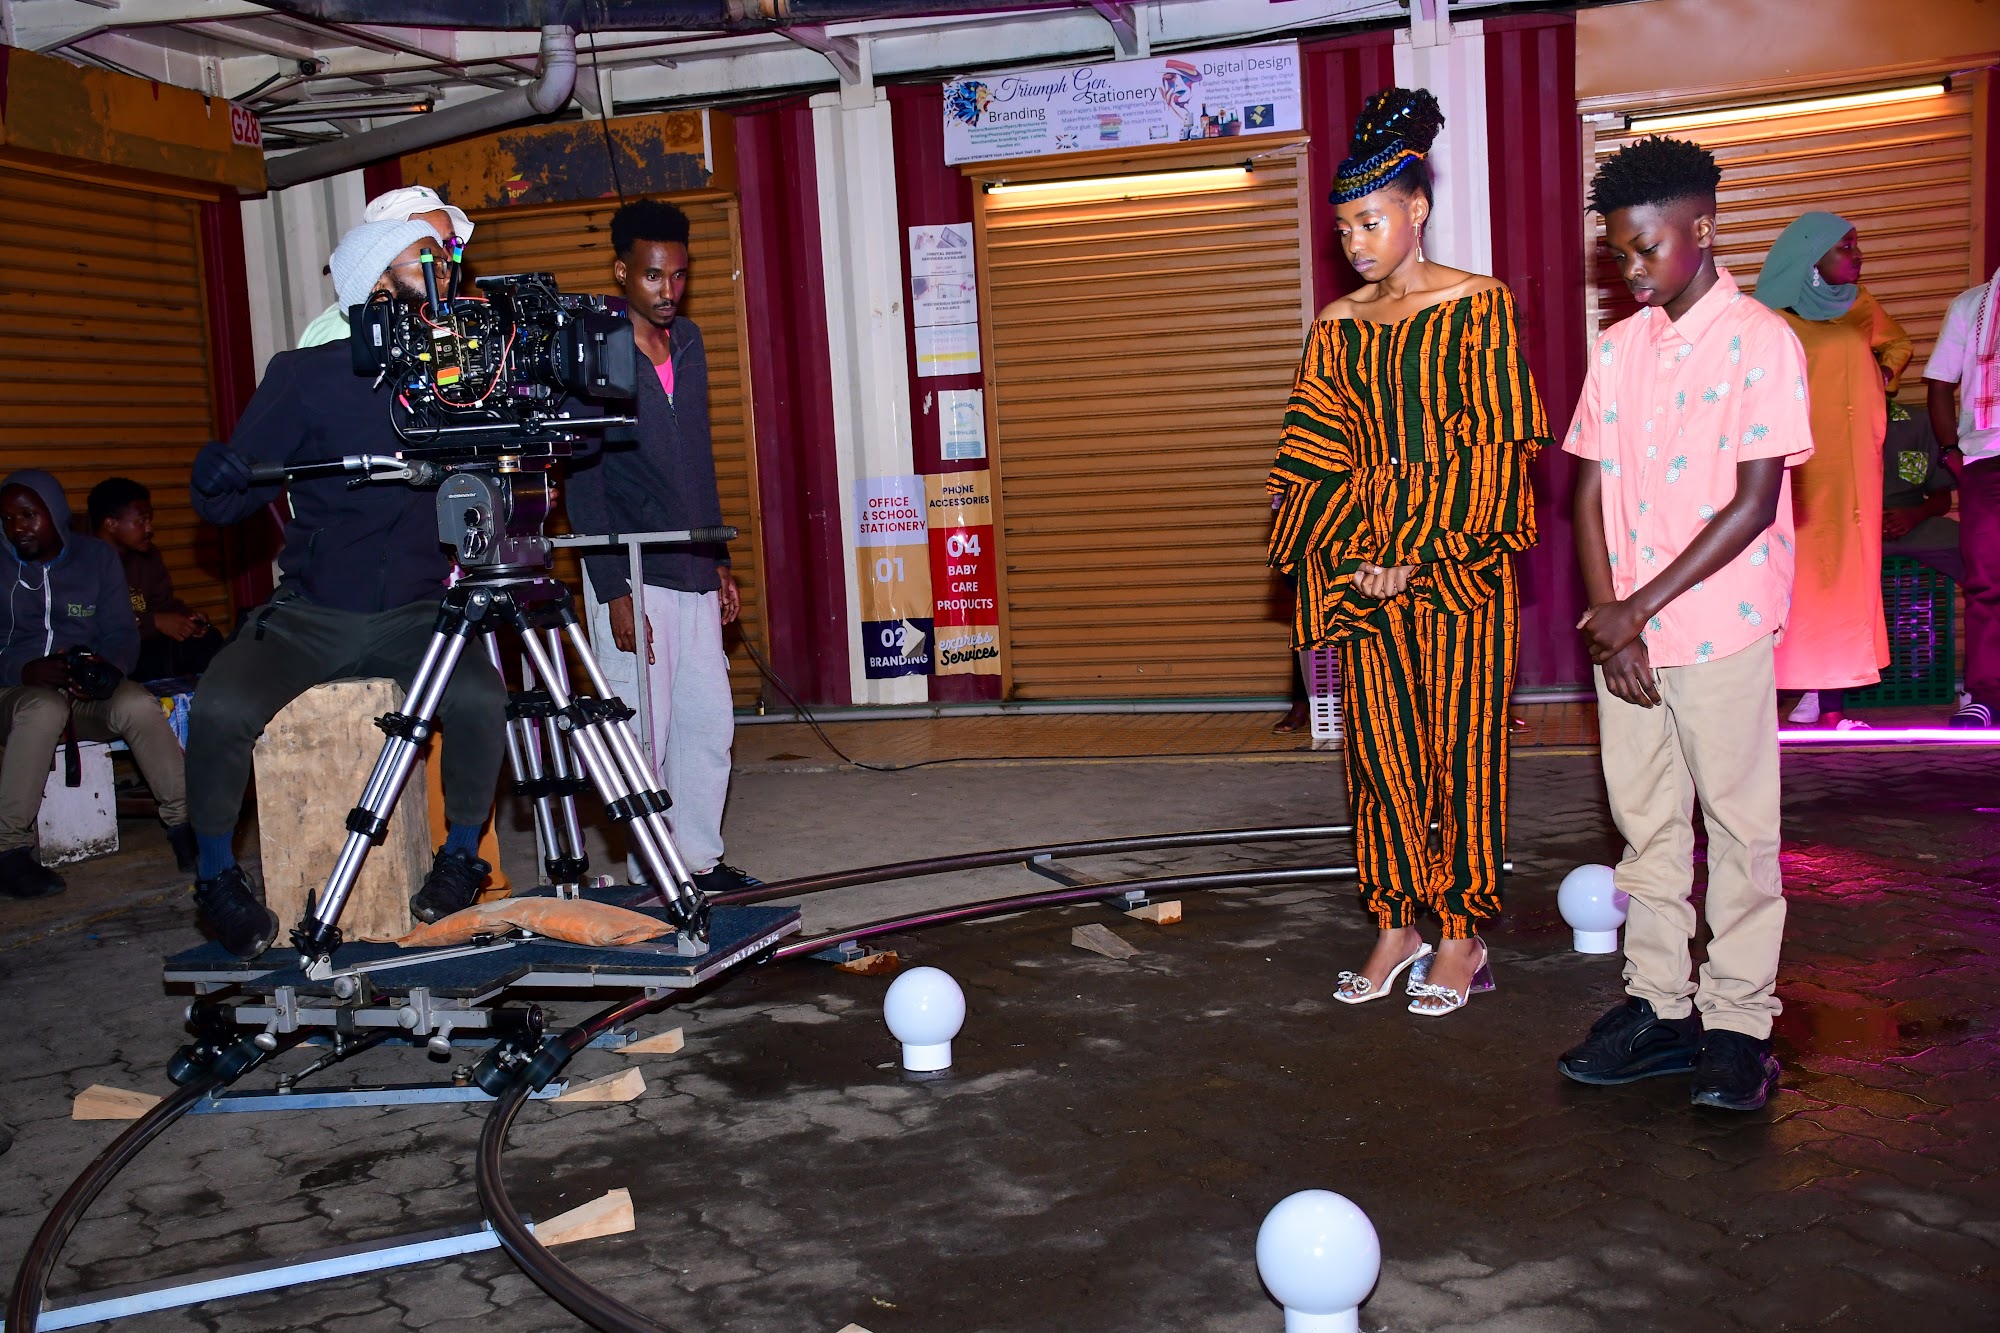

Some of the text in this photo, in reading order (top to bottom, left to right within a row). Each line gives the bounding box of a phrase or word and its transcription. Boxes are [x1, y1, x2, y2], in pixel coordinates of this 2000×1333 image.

[1204, 56, 1292, 77] Digital Design
[994, 76, 1068, 102] Triumph
[1086, 87, 1158, 104] Stationery
[989, 107, 1046, 123] Branding
[232, 108, 259, 144] G28
[942, 485, 974, 495] PHONE
[868, 497, 909, 508] OFFICE
[929, 496, 990, 508] ACCESSORIES
[863, 509, 918, 521] & SCHOOL
[860, 520, 926, 533] STATIONERY
[947, 534, 981, 558] 04
[875, 558, 905, 583] 01
[948, 564, 978, 576] BABY
[951, 582, 978, 593] CARE
[937, 599, 993, 610] PRODUCTS
[881, 628, 908, 648] 02
[939, 631, 994, 651] express
[870, 654, 928, 667] BRANDING
[940, 646, 999, 666] Services
